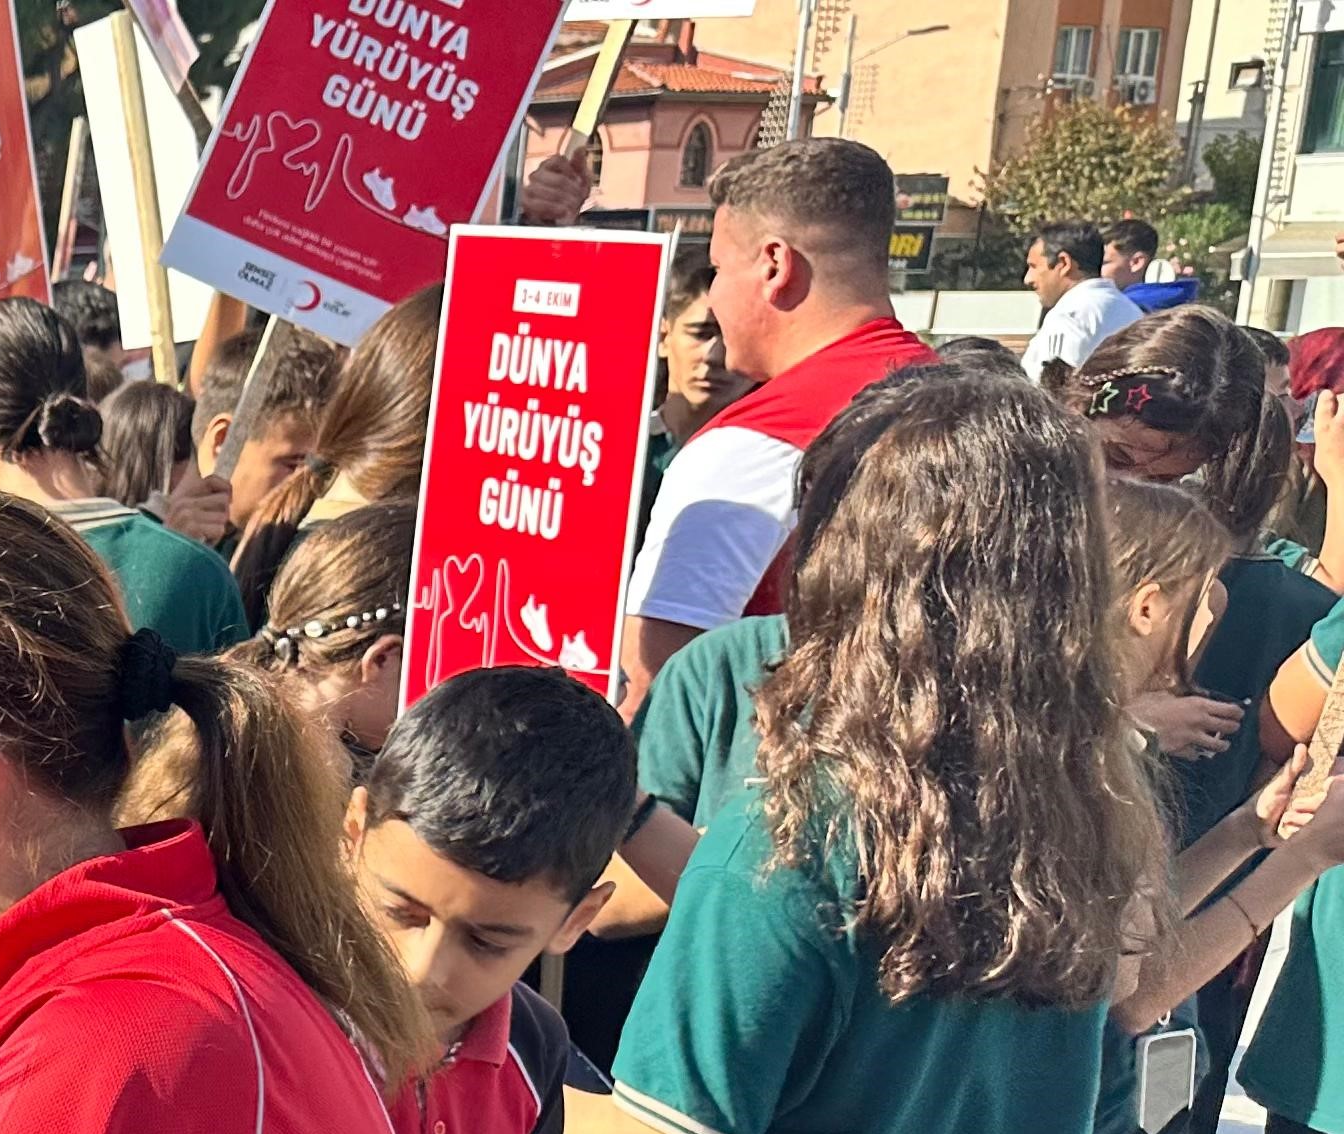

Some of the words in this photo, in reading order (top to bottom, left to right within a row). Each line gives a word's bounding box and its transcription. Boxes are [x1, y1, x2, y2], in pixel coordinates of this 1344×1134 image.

[311, 13, 479, 121] YÜRÜYÜŞ
[323, 74, 428, 141] GÜNÜ
[546, 290, 572, 308] EKİM
[488, 321, 587, 393] DÜNYA
[464, 391, 603, 486] YÜRÜYÜŞ
[478, 468, 563, 540] GÜNÜ
